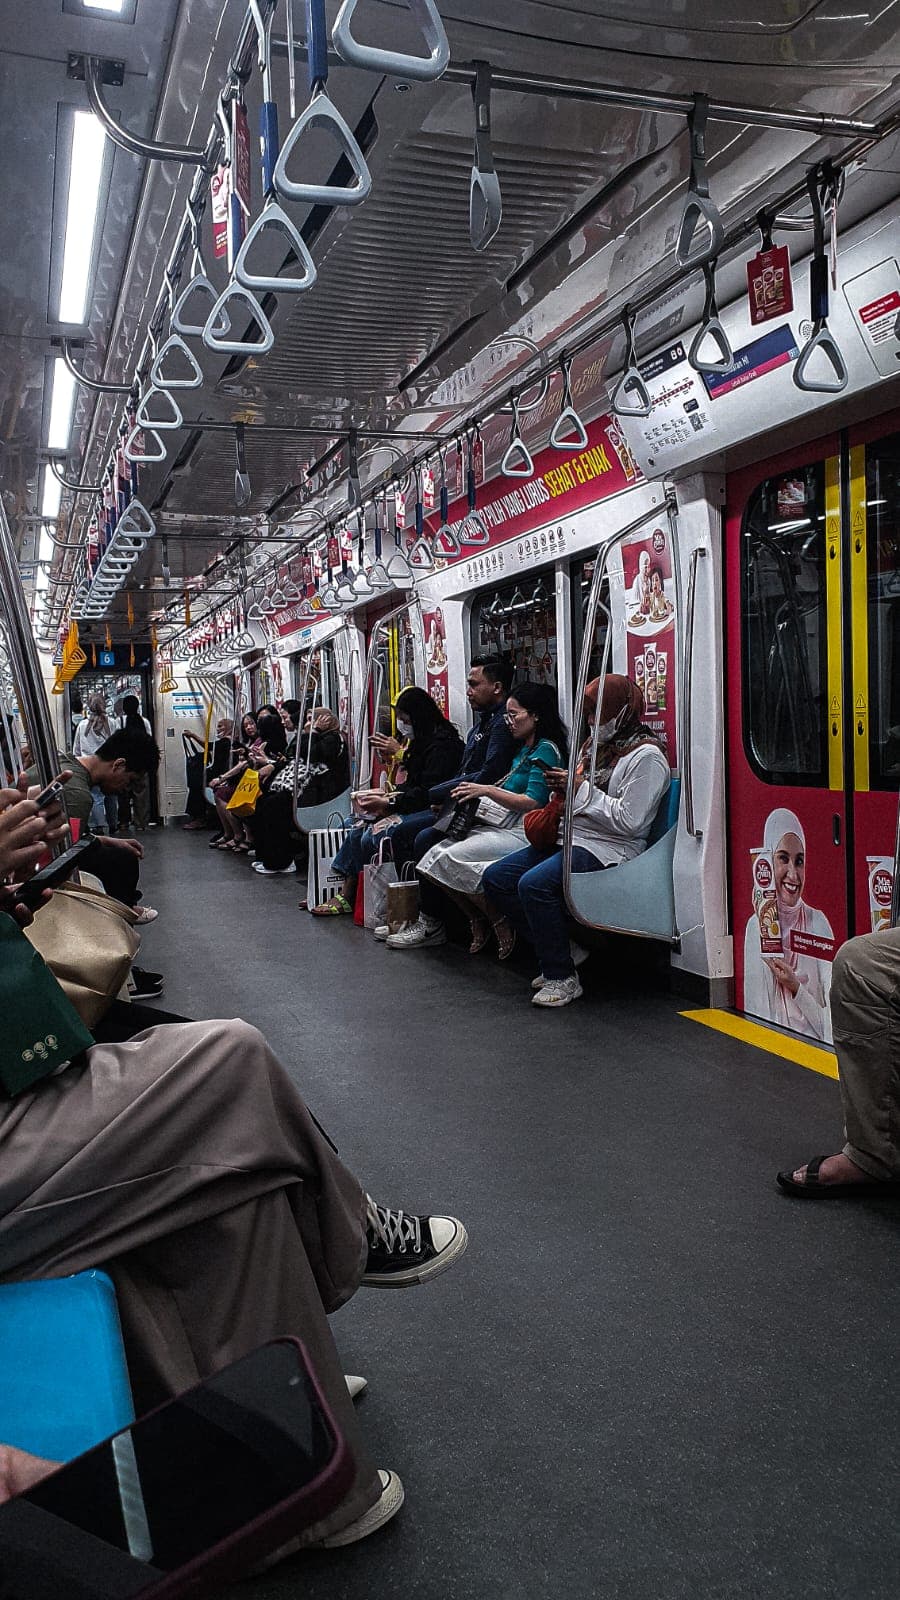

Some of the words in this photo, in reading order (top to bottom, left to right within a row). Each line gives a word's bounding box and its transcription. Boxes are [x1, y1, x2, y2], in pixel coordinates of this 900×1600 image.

[486, 498, 508, 527] PILIH
[502, 491, 526, 518] YANG
[521, 478, 551, 510] LURUS
[543, 463, 577, 498] SEHAT
[573, 459, 585, 485] &
[579, 444, 613, 480] ENAK
[104, 653, 111, 664] 6
